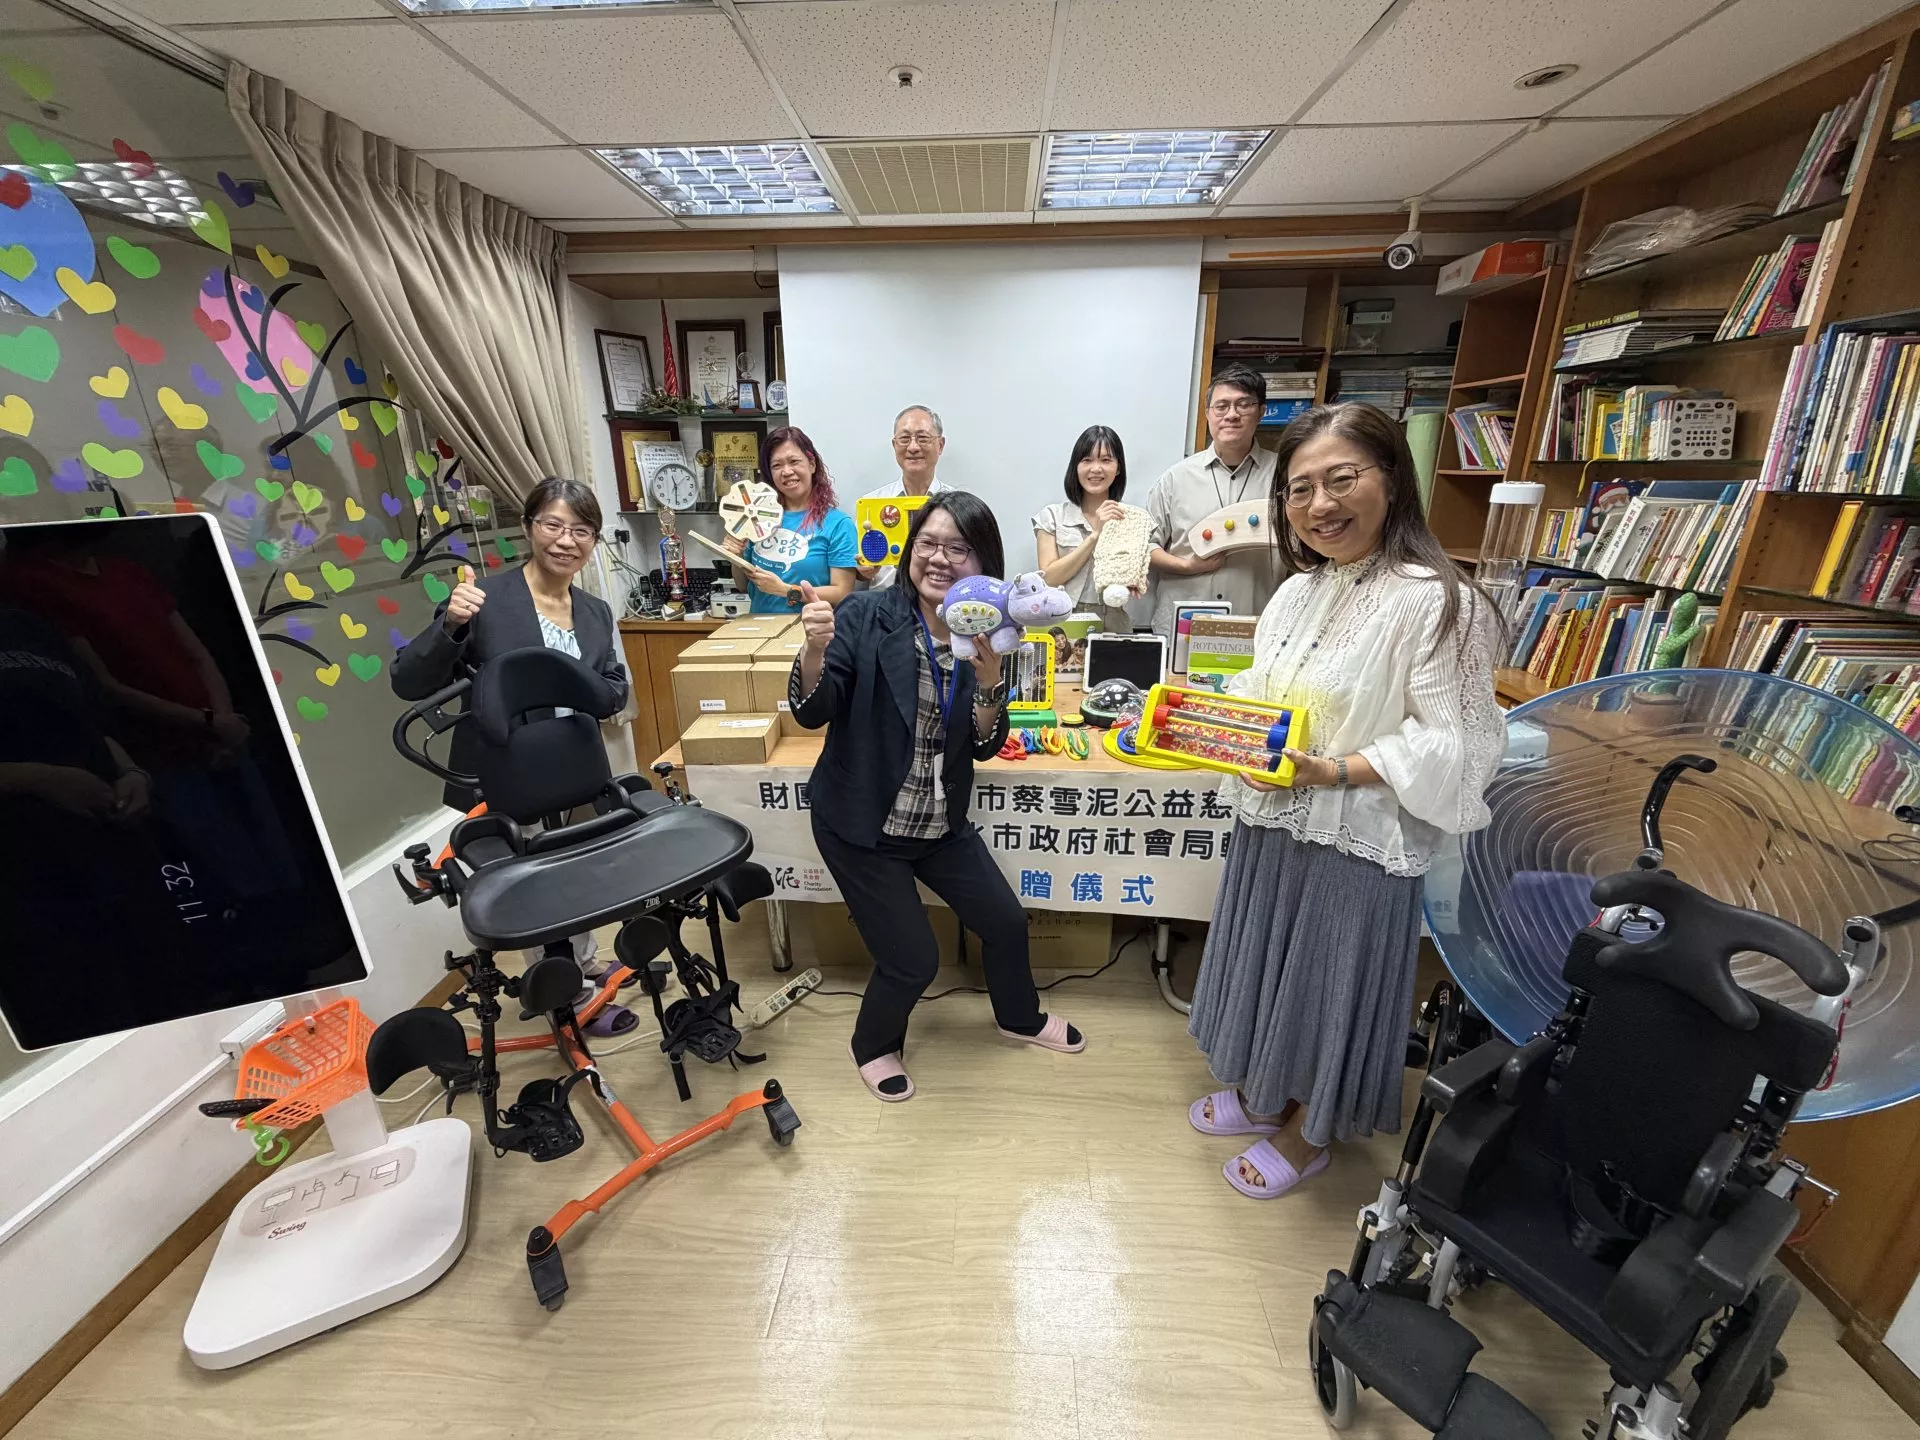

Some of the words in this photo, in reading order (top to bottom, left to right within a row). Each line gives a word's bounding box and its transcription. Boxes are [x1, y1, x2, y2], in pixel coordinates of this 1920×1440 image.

[1193, 641, 1242, 652] ROTATING
[976, 783, 1232, 819] 市蔡雪泥公益慈
[970, 821, 1231, 861] 市政府社會局
[1020, 869, 1155, 906] 贈儀式
[267, 1221, 307, 1240] Swing
